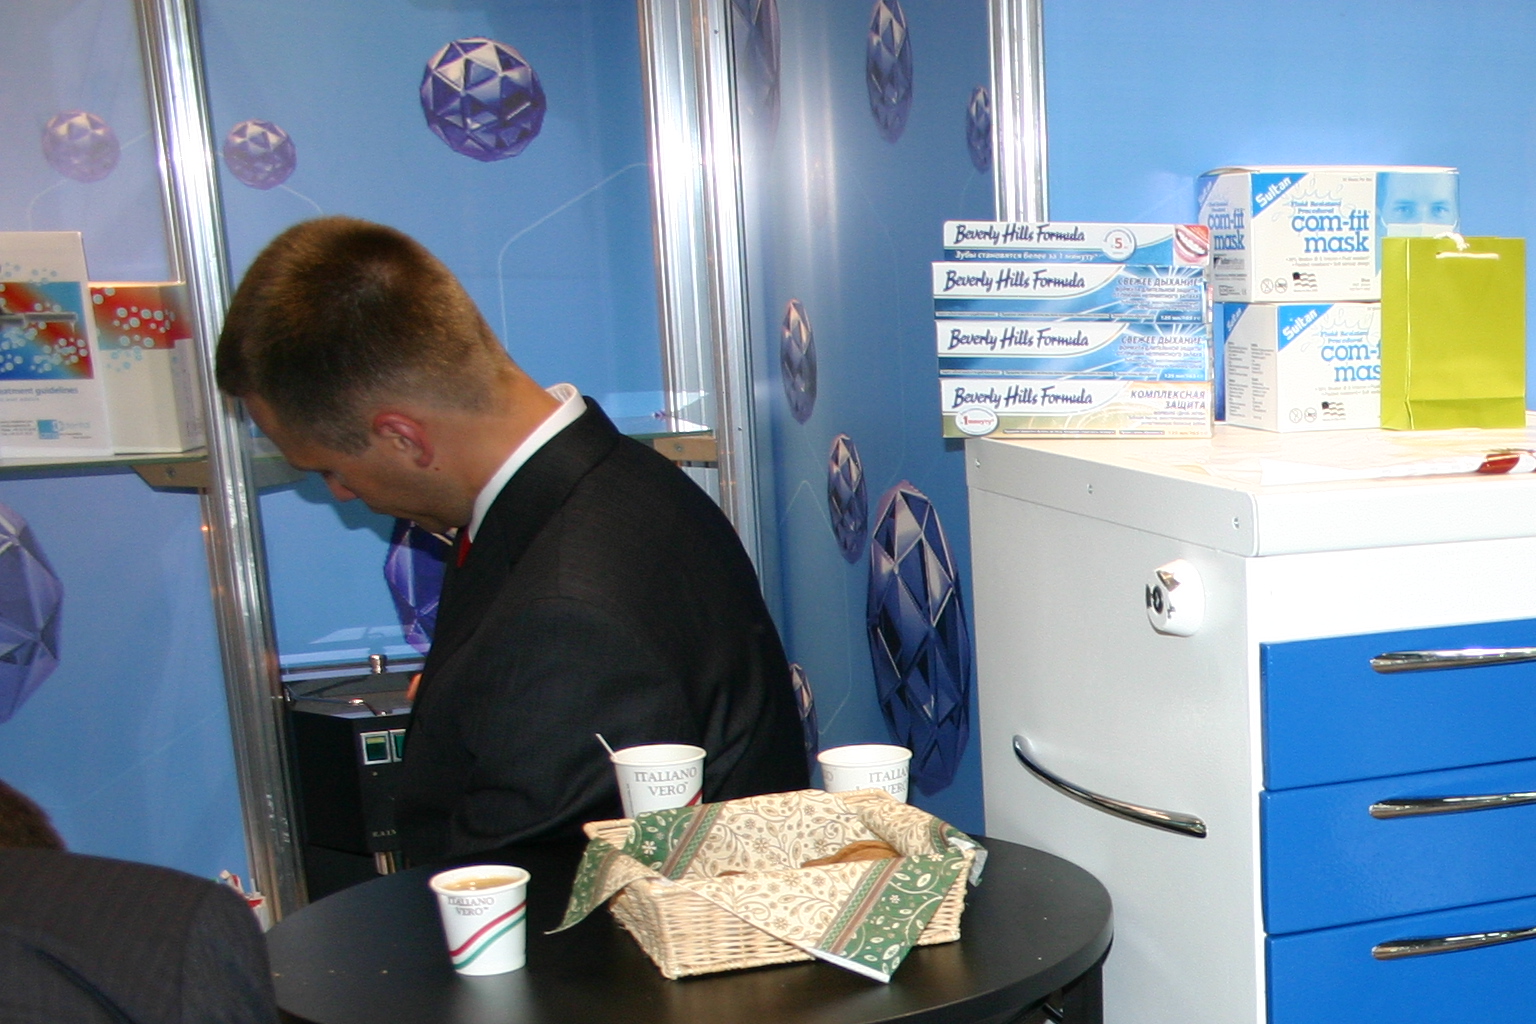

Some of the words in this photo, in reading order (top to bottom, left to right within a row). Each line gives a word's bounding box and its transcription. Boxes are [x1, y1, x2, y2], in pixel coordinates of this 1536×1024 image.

[1255, 177, 1292, 207] Sultan
[1208, 208, 1245, 230] com-fit
[1291, 209, 1369, 232] com-fit
[953, 224, 1000, 245] Beverly
[1002, 223, 1034, 245] Hills
[1036, 223, 1085, 243] Formula
[1114, 237, 1125, 249] 5
[1214, 230, 1245, 250] mask
[1304, 231, 1370, 253] mask
[943, 268, 993, 292] Beverly
[994, 267, 1030, 291] Hills
[1031, 269, 1085, 291] Formula
[1118, 277, 1151, 286] СВЕЖЕЕ
[1154, 277, 1199, 287] ДЫХАНИЕ
[1282, 309, 1318, 341] Sultan
[948, 327, 997, 350] Beverly
[999, 326, 1034, 350] Hills
[1035, 327, 1089, 348] Formula
[1121, 335, 1155, 344] СВЕЖЕЕ
[1157, 335, 1201, 345] ДЫХАНИЕ
[1322, 338, 1381, 362] com-f
[1334, 365, 1381, 382] mas
[35, 387, 79, 396] guidelines
[952, 385, 1001, 408] Beverly
[1003, 384, 1038, 408] Hills
[1040, 385, 1093, 406] Formula
[1130, 390, 1205, 399] КОМПЛЕКСНАЯ
[1164, 400, 1206, 410] ЗАЩИТА
[634, 767, 697, 782] ITALIANO
[869, 766, 909, 783] ITALIA
[882, 782, 906, 795] VER
[448, 896, 494, 906] ITALIANO
